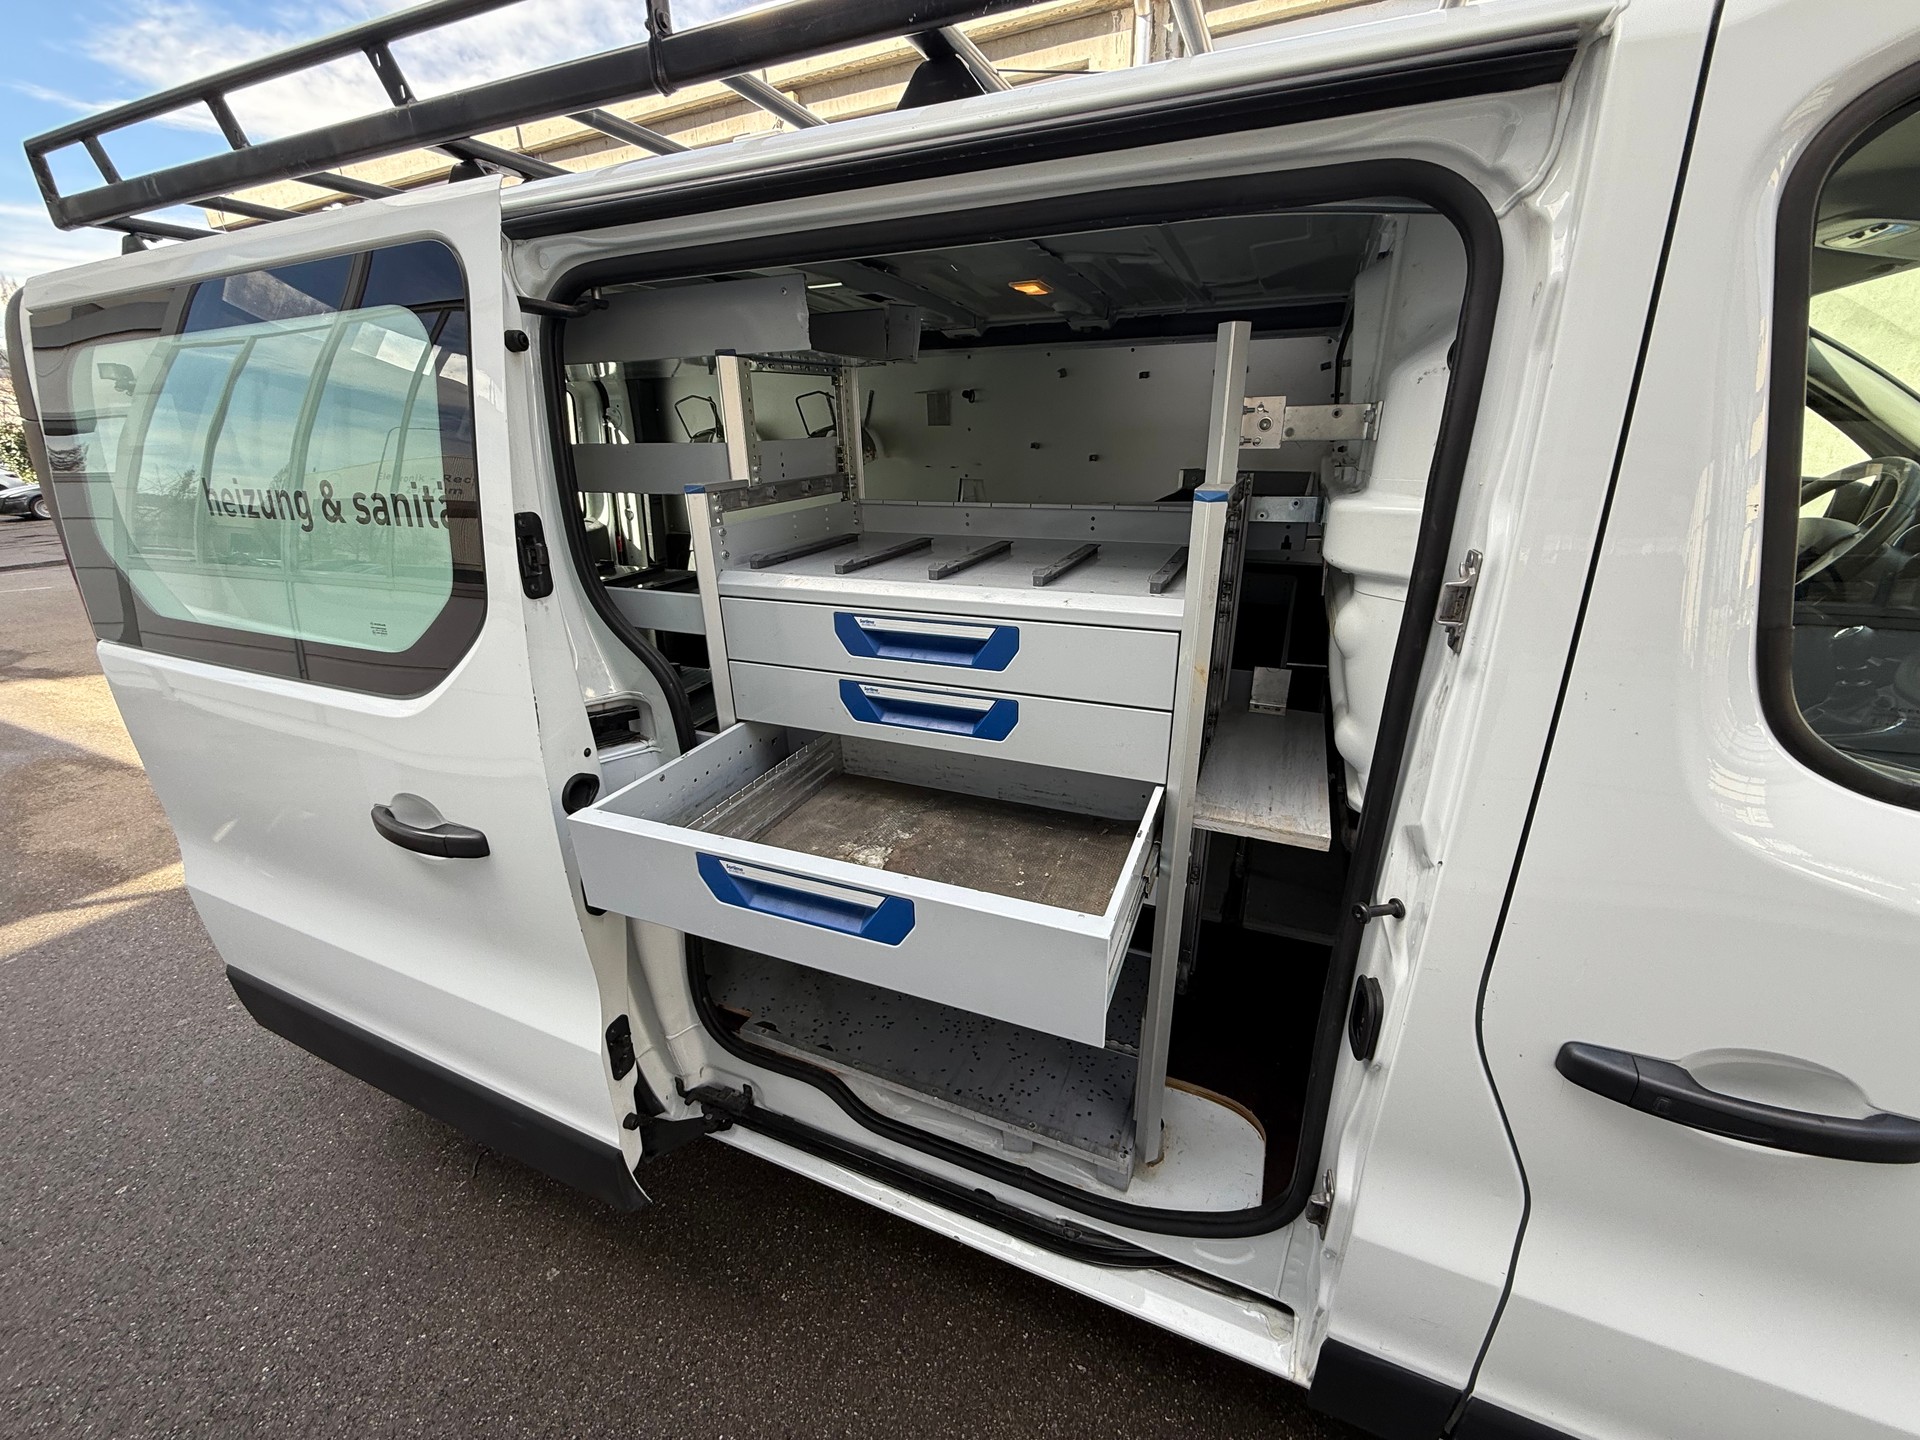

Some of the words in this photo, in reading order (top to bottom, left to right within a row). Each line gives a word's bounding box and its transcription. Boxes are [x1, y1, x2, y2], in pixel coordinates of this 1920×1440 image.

[378, 472, 424, 482] Eleronik
[201, 477, 313, 532] heizung
[319, 479, 346, 524] &
